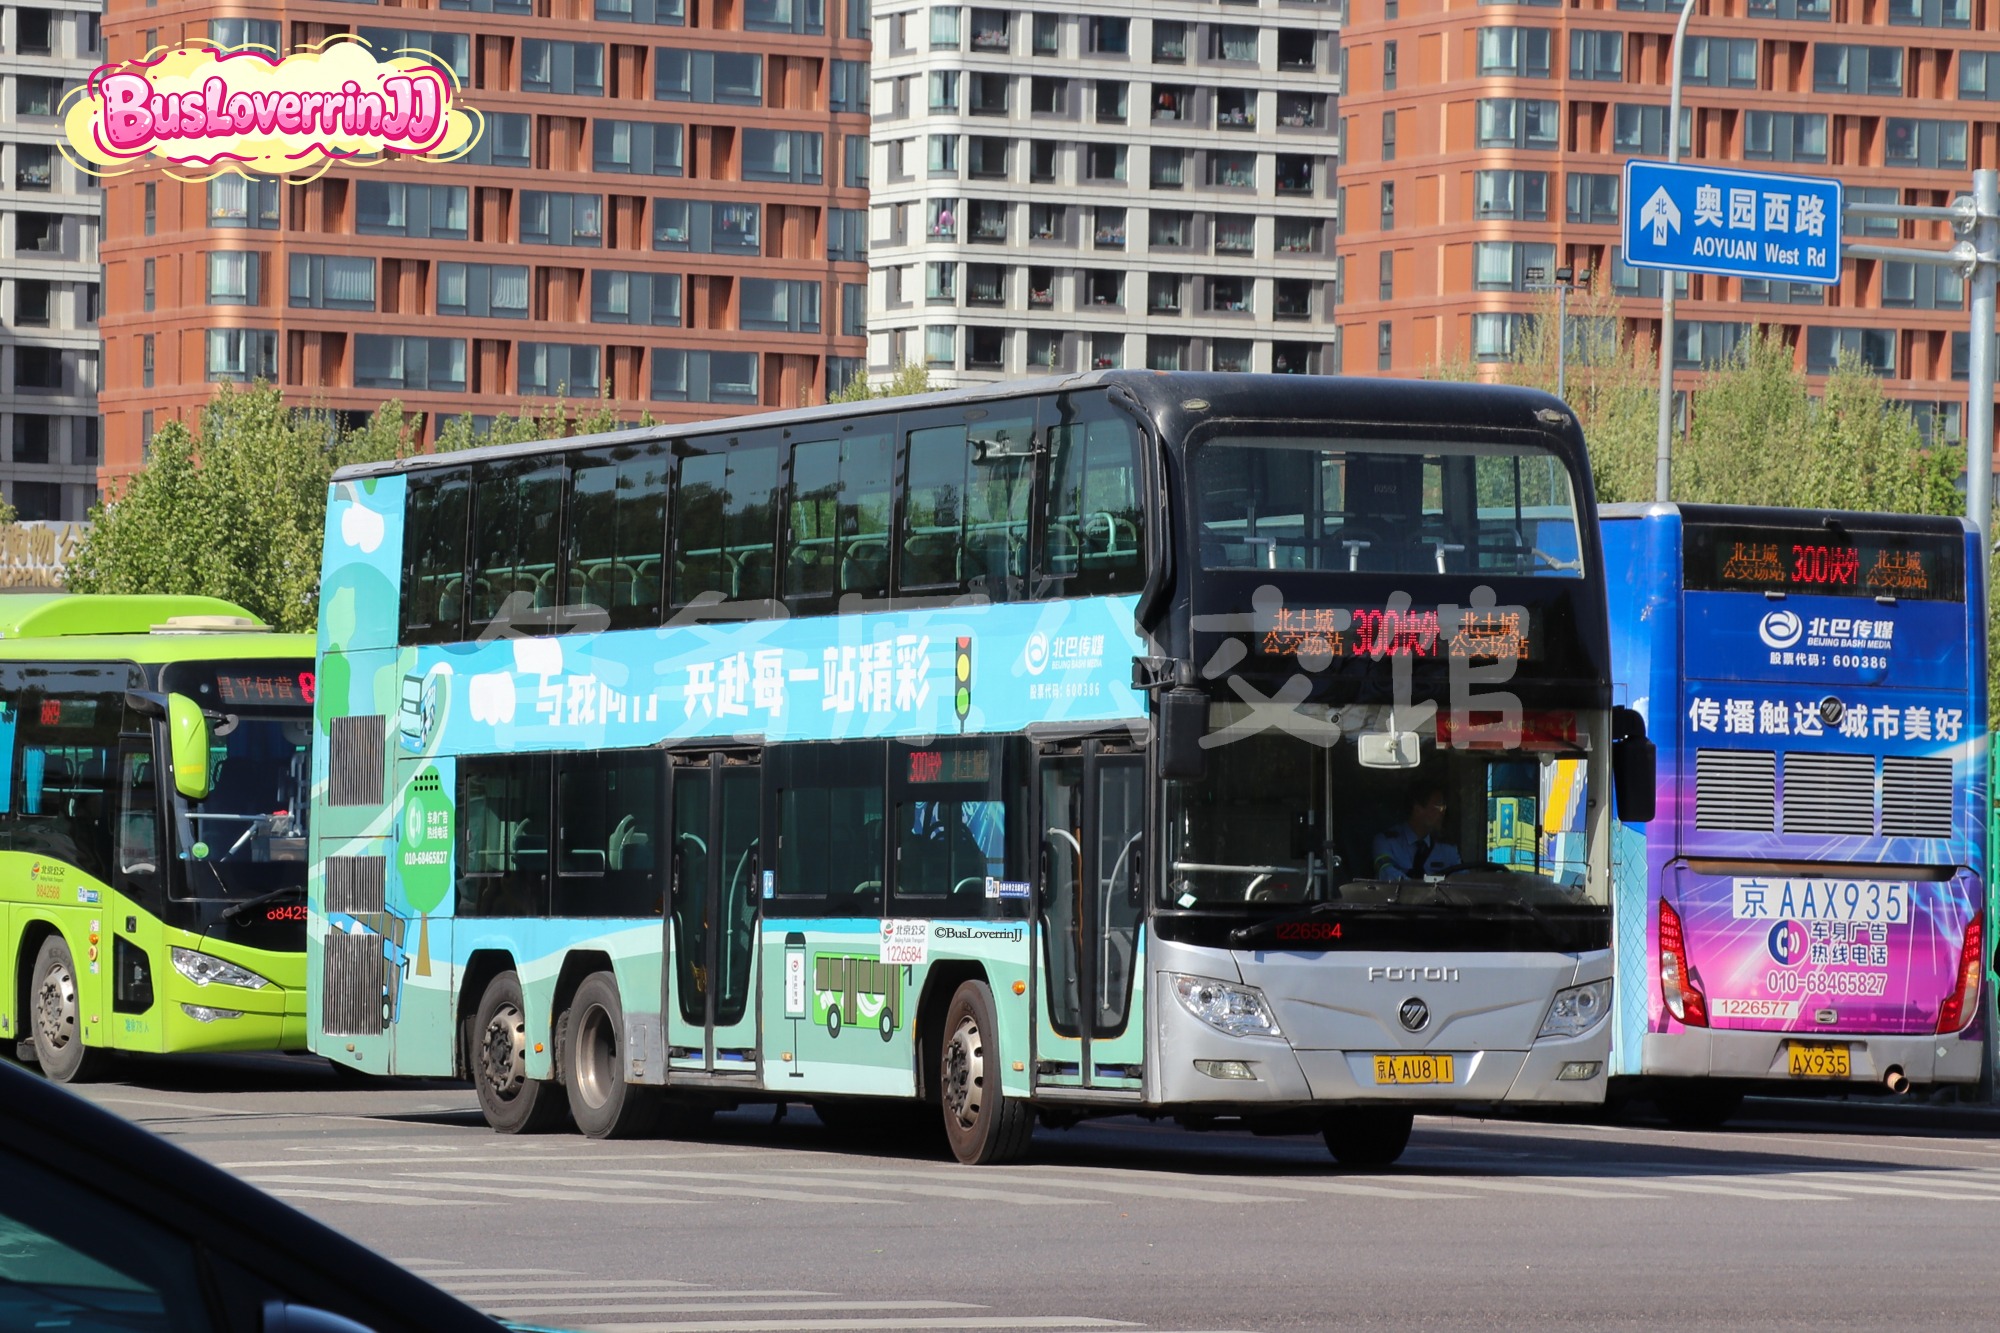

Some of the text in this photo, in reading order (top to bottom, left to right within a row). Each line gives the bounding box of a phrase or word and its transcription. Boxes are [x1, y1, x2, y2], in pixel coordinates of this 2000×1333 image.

[1655, 198, 1668, 216] 北
[1693, 184, 1827, 238] 奥园西路
[1655, 225, 1665, 240] N
[1693, 236, 1826, 268] AOYUAN West Rd
[1731, 542, 1779, 563] 北土城
[1874, 550, 1922, 571] 北土城
[1722, 560, 1787, 582] 公交场站
[1791, 545, 1860, 584] 300快外
[1866, 567, 1929, 589] 公交场站
[1272, 608, 1335, 632] 北土城
[1460, 611, 1521, 636] 北土城
[1807, 617, 1895, 640] 北巴传媒
[1261, 631, 1344, 656] 公交场站
[1352, 609, 1441, 657] 300快外
[1807, 636, 1892, 650] BEIJING BASHI MEDIA
[1052, 634, 1104, 658] 北巴传媒
[1449, 635, 1530, 660] 公交场站
[683, 634, 931, 719] 共赴每一站精彩
[427, 811, 449, 824] 车身广告
[404, 851, 448, 865] 010-68465827
[41, 865, 66, 876] 北京公交
[896, 925, 926, 936] 北京公交
[1276, 923, 1342, 940] 1226584
[1811, 921, 1889, 943] 车身广告
[886, 945, 922, 962] 1226584
[1811, 944, 1889, 966] 热线电话
[1368, 966, 1459, 981] FOTON
[1767, 969, 1888, 996] 010-68465827
[1721, 1000, 1790, 1016] 1226577
[1792, 1054, 1848, 1075] AX935
